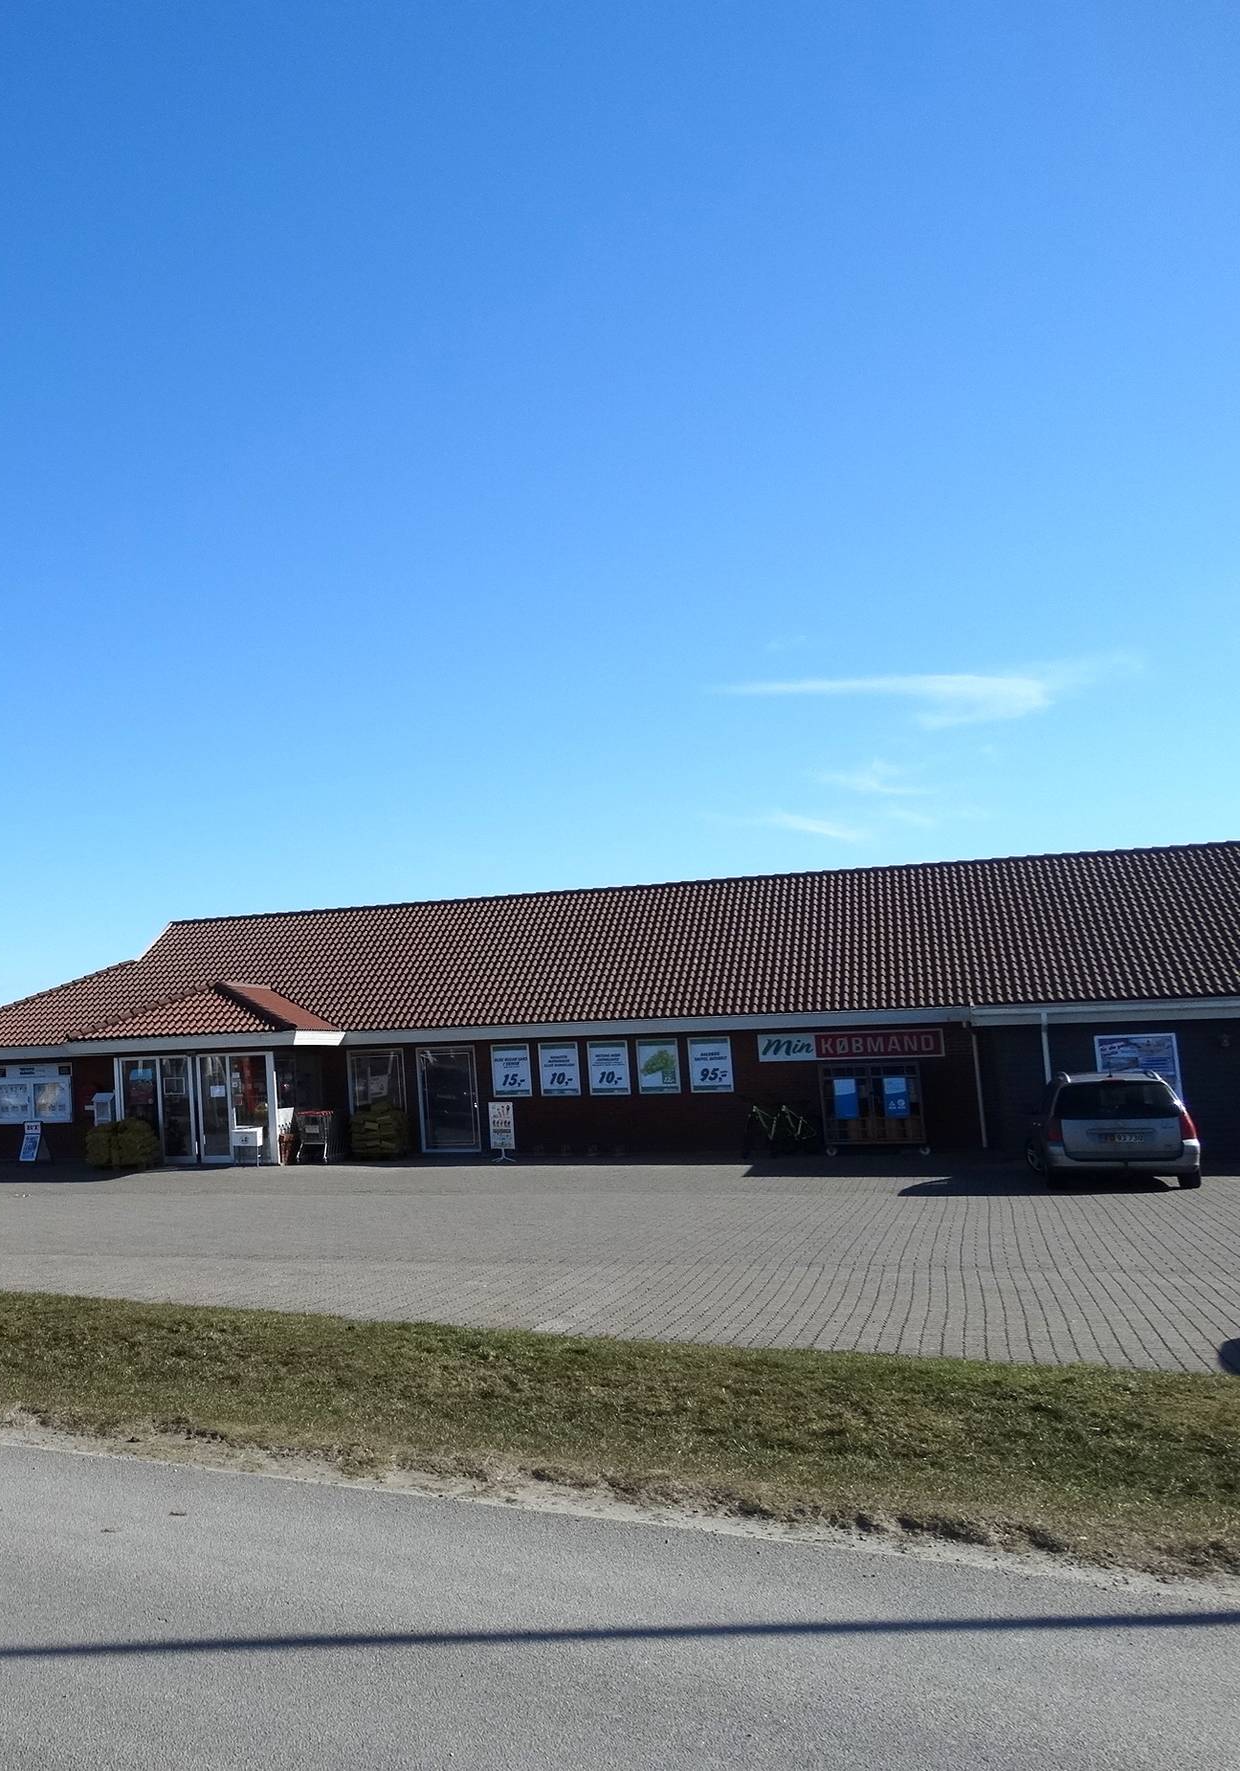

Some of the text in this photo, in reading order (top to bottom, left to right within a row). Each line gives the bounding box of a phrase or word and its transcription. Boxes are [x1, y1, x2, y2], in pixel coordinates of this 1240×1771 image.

[761, 1034, 935, 1057] Min KØBMAND
[502, 1073, 526, 1087] 15,-
[550, 1072, 574, 1086] 10,-
[598, 1071, 622, 1085] 10,-
